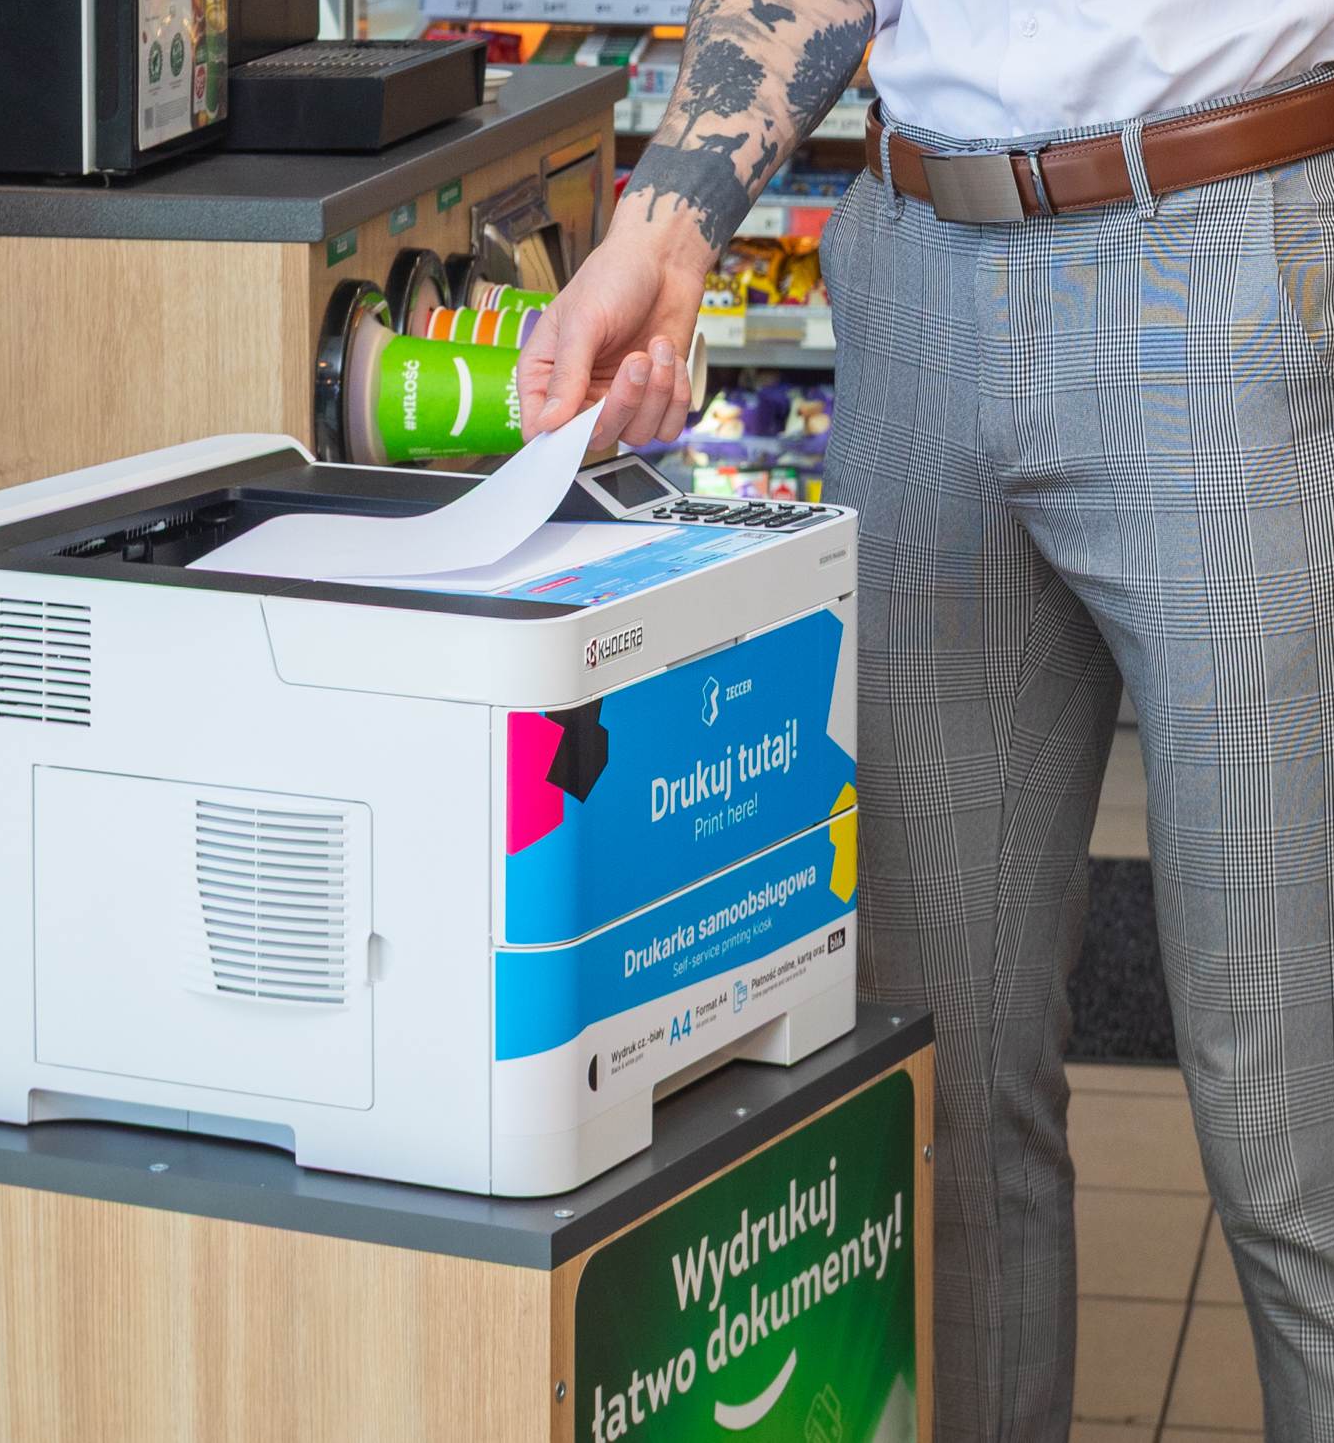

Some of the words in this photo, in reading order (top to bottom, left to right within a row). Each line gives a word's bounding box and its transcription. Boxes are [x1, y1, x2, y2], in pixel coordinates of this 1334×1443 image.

[403, 360, 421, 431] #MIŁOŚĆ
[598, 626, 643, 659] KYOCERA
[725, 679, 752, 701] ZECCER
[651, 745, 732, 823] Drukuj
[738, 718, 798, 782] tutaj!
[694, 807, 724, 842] Print
[727, 792, 758, 827] here!
[624, 925, 695, 978] Drukarka
[698, 865, 816, 940] samoobsługowa
[673, 944, 720, 978] Self-service
[722, 926, 751, 954] printing
[753, 917, 773, 936] kiosk
[670, 1009, 692, 1046] A4
[695, 1000, 718, 1019] Format
[719, 992, 728, 1007] A4
[610, 1042, 636, 1064] Wydruk
[671, 1156, 838, 1312] Wydrukuj
[591, 1347, 696, 1443] łatwo
[706, 1191, 903, 1374] dokumenty!
